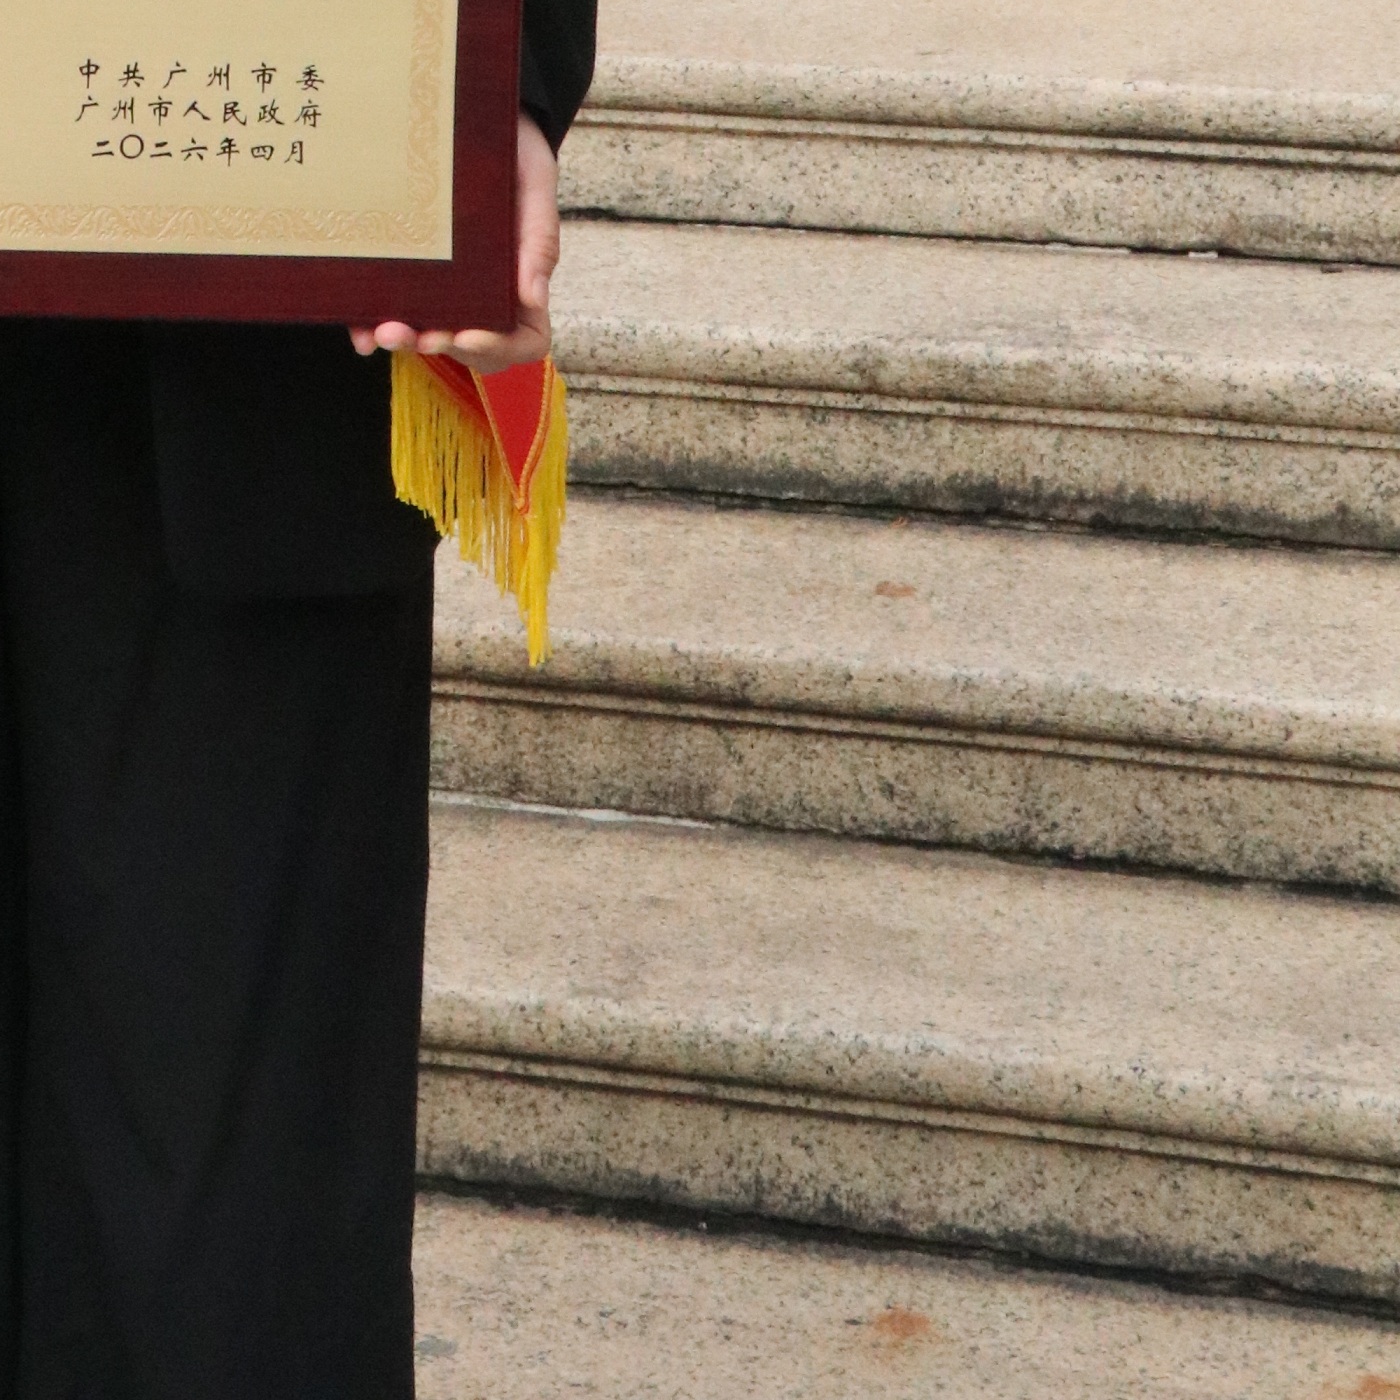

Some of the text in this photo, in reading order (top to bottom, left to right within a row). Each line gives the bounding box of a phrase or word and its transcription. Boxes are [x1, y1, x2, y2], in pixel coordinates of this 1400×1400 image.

[78, 58, 325, 94] 中共广州市委
[74, 95, 322, 129] 广州市人民政府
